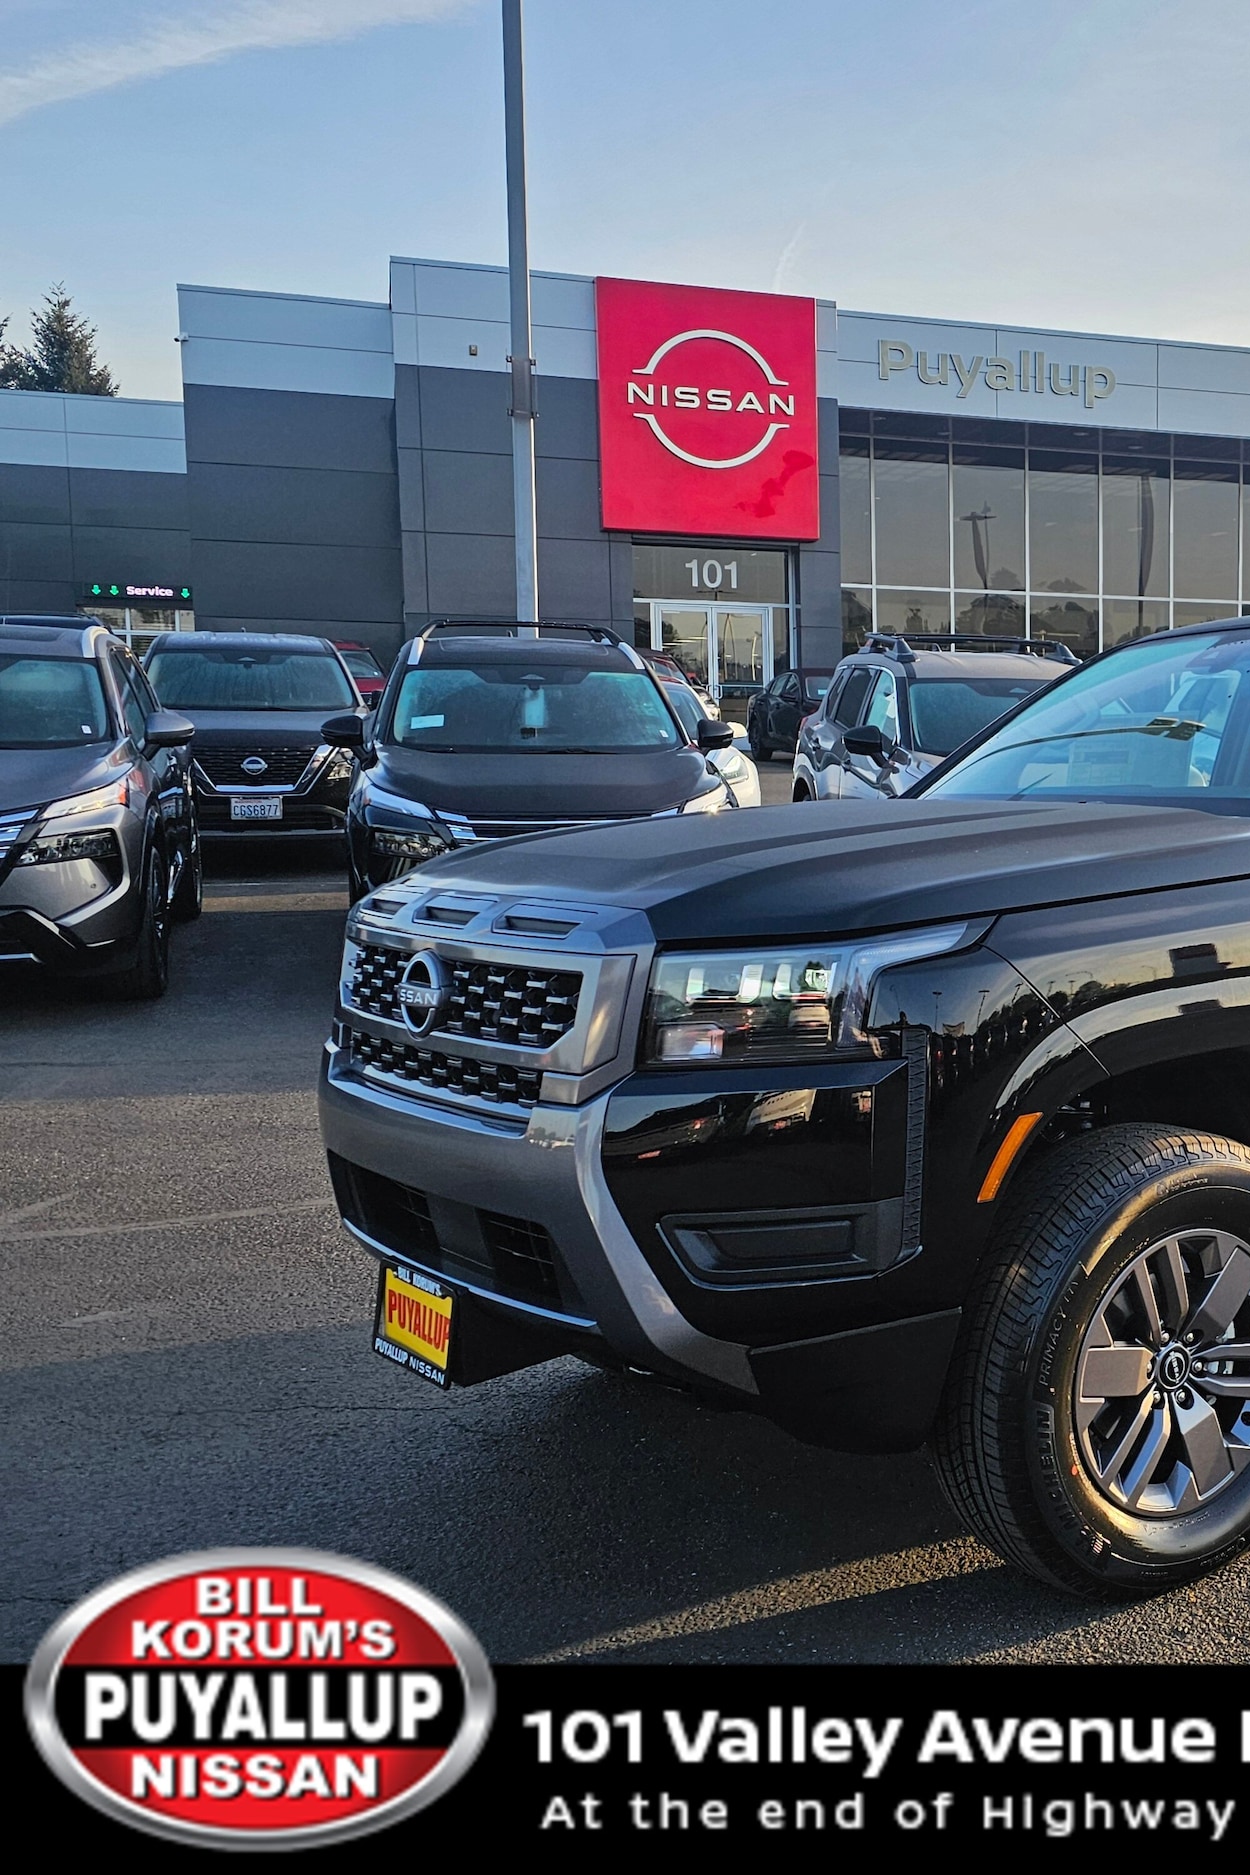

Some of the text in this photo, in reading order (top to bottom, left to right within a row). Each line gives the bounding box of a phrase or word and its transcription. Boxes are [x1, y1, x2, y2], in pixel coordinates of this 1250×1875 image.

[877, 339, 1116, 409] Puyallup
[627, 382, 794, 416] NISSAN
[684, 559, 739, 589] 101
[126, 586, 174, 597] Service
[233, 804, 279, 817] CGS6877
[399, 988, 438, 1006] SSAN
[387, 1289, 452, 1353] PUYALLUP
[374, 1338, 446, 1386] PUYALLUP NISSAN
[1037, 1311, 1068, 1387] PRIMACY
